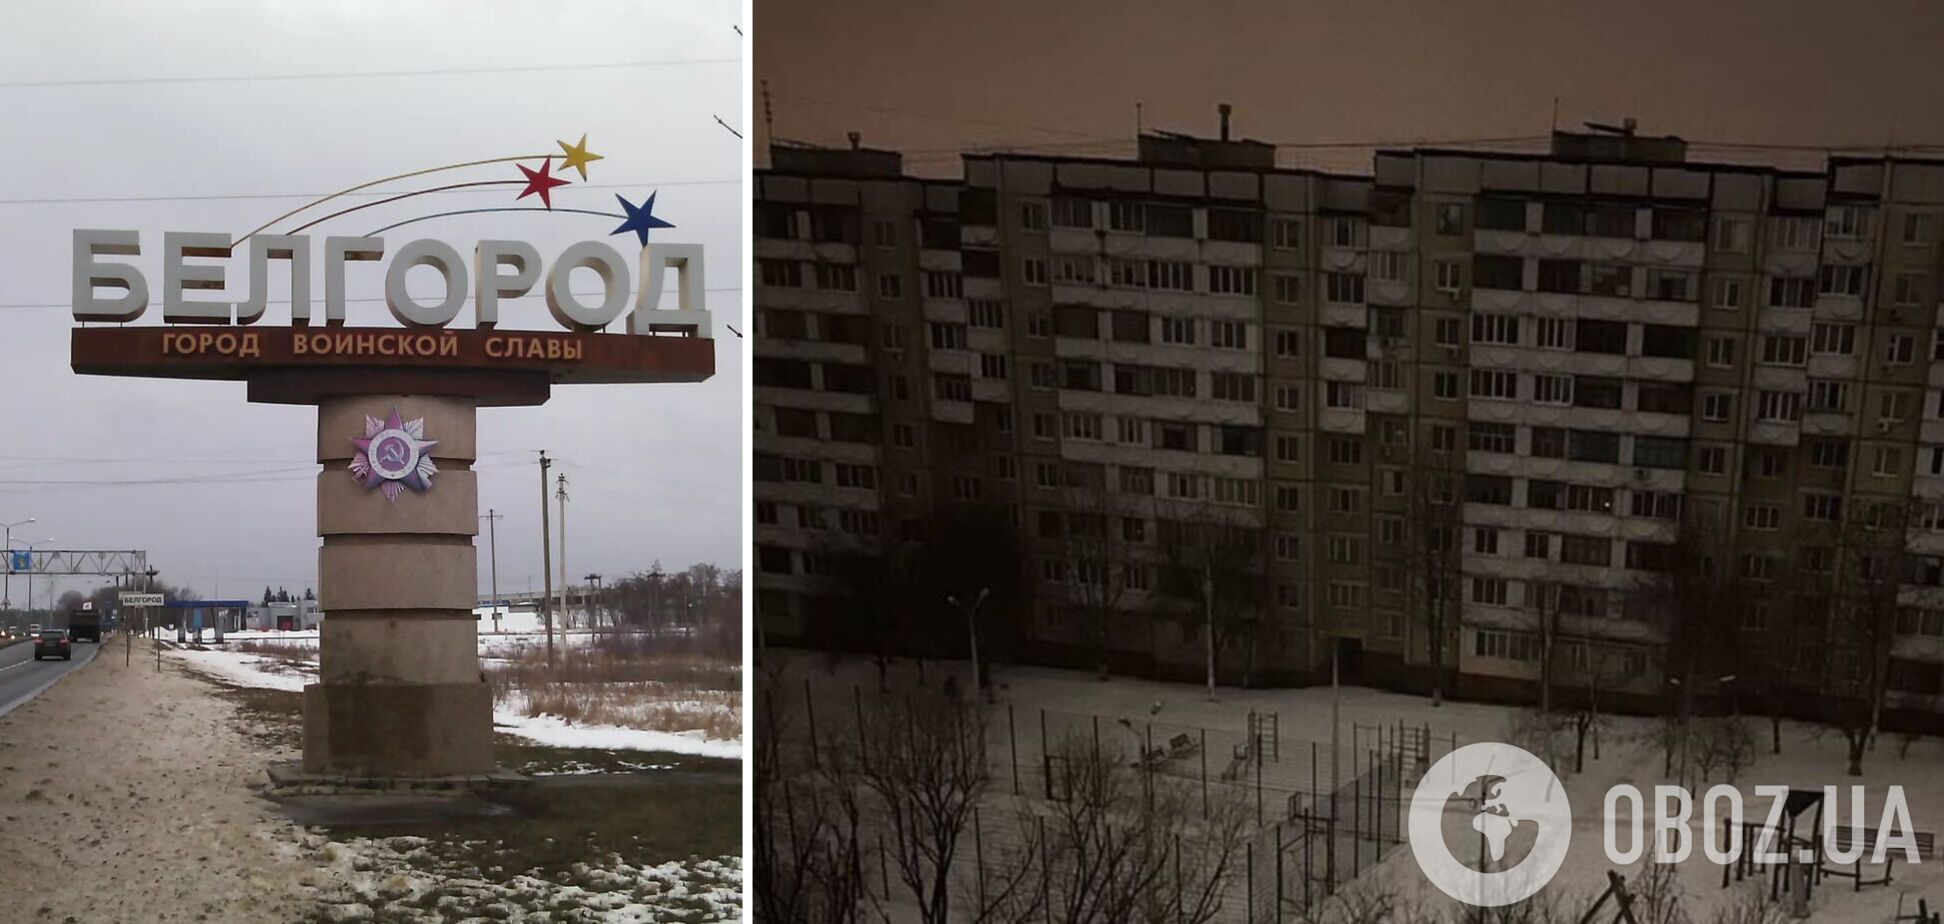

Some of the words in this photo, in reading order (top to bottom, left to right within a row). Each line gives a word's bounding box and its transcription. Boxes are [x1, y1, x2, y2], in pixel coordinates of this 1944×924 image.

[72, 228, 712, 338] БЕЛГОРОД
[162, 333, 260, 358] ГОРОД
[293, 330, 458, 357] ВОИНСКОЙ
[485, 337, 582, 360] СЛАВЫ
